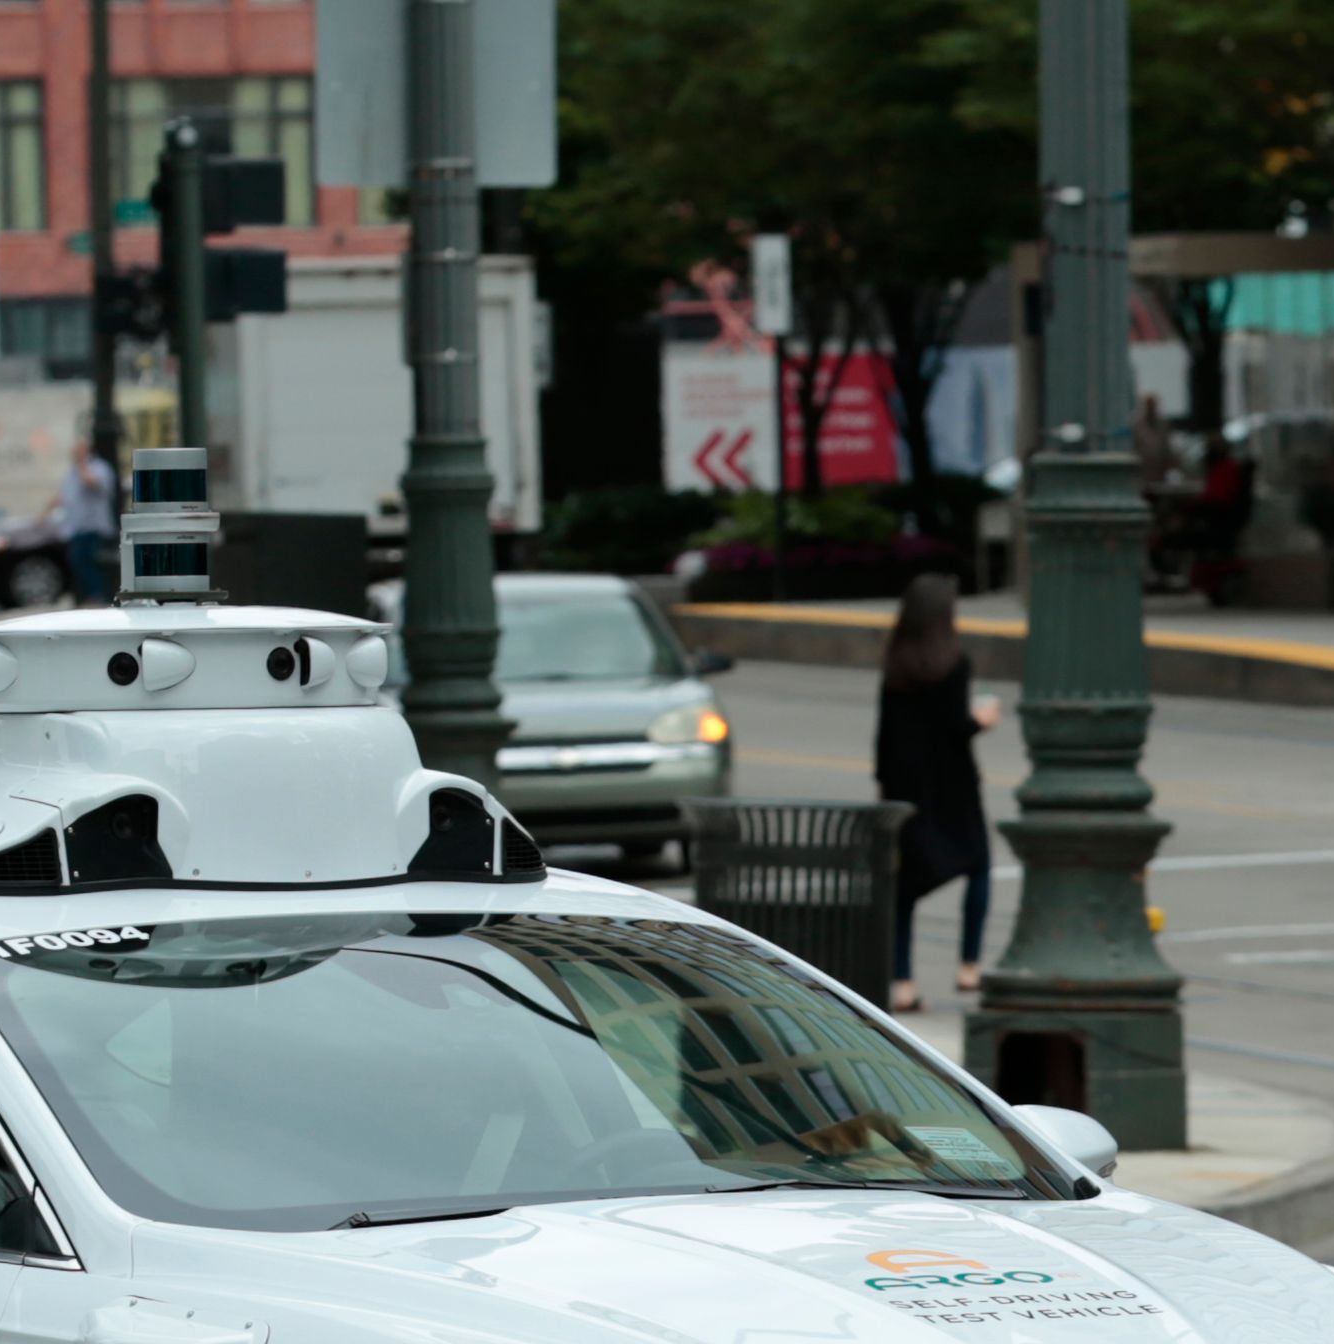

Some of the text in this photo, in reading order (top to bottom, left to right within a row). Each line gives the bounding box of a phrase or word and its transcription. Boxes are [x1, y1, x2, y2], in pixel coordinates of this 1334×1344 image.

[864, 1270, 1055, 1292] ARGO
[888, 1289, 1138, 1311] SELF-DRIVING
[914, 1303, 1163, 1325] TEST VEHICLE
